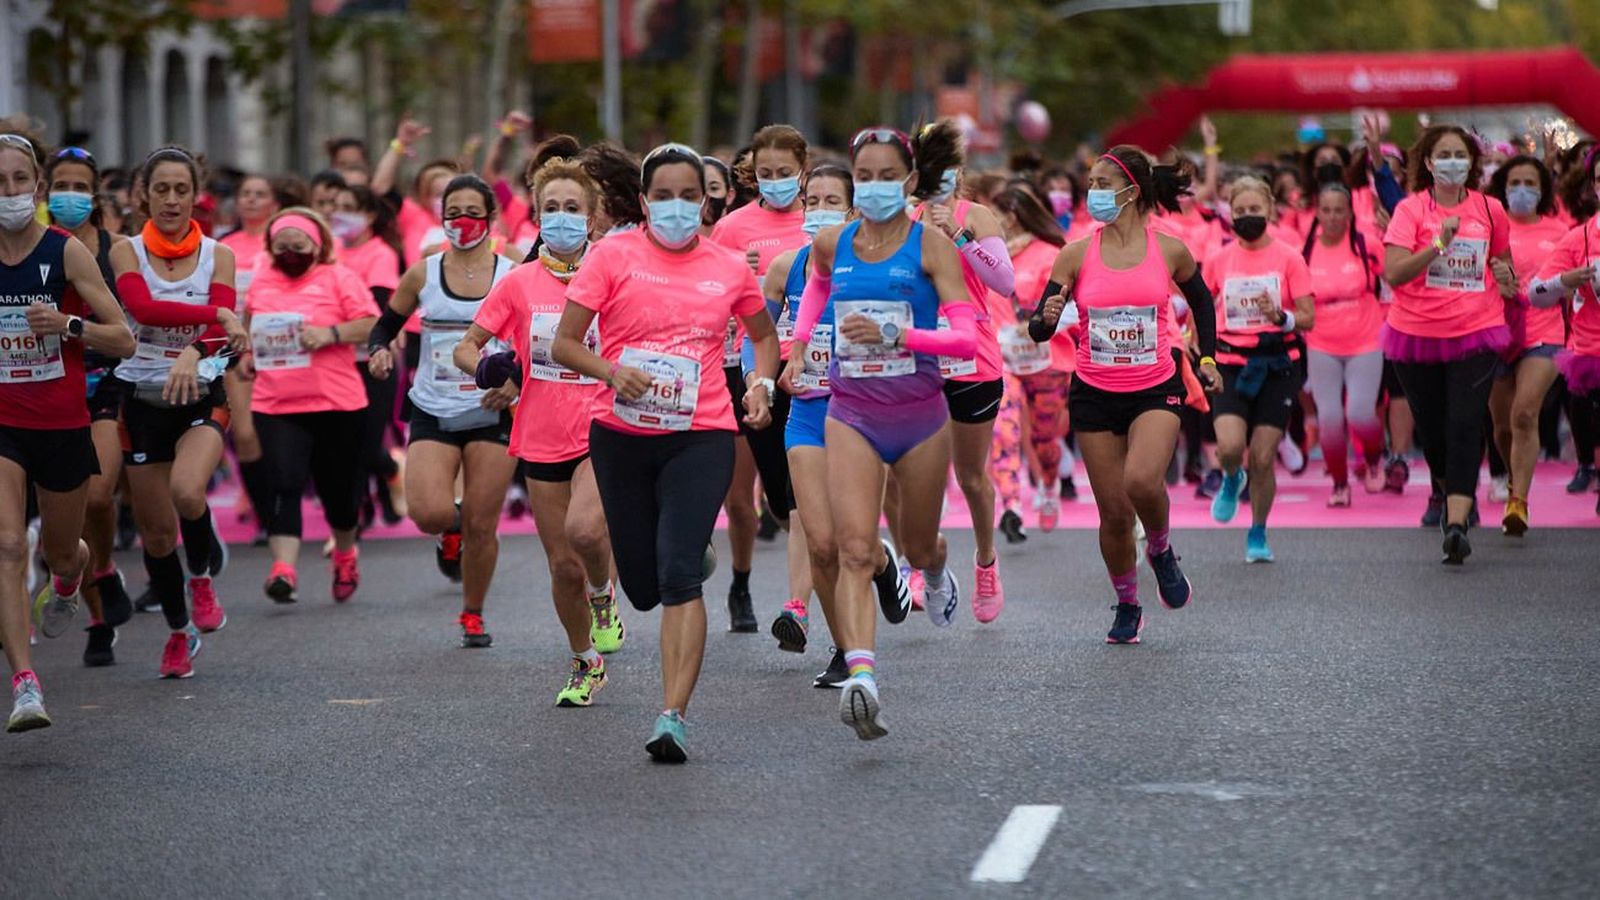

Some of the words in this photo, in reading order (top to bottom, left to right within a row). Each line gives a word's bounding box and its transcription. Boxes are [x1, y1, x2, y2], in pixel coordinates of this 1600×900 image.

[1109, 329, 1137, 341] 016
[1, 337, 36, 350] 016
[811, 350, 830, 362] 01
[652, 383, 673, 399] 16
